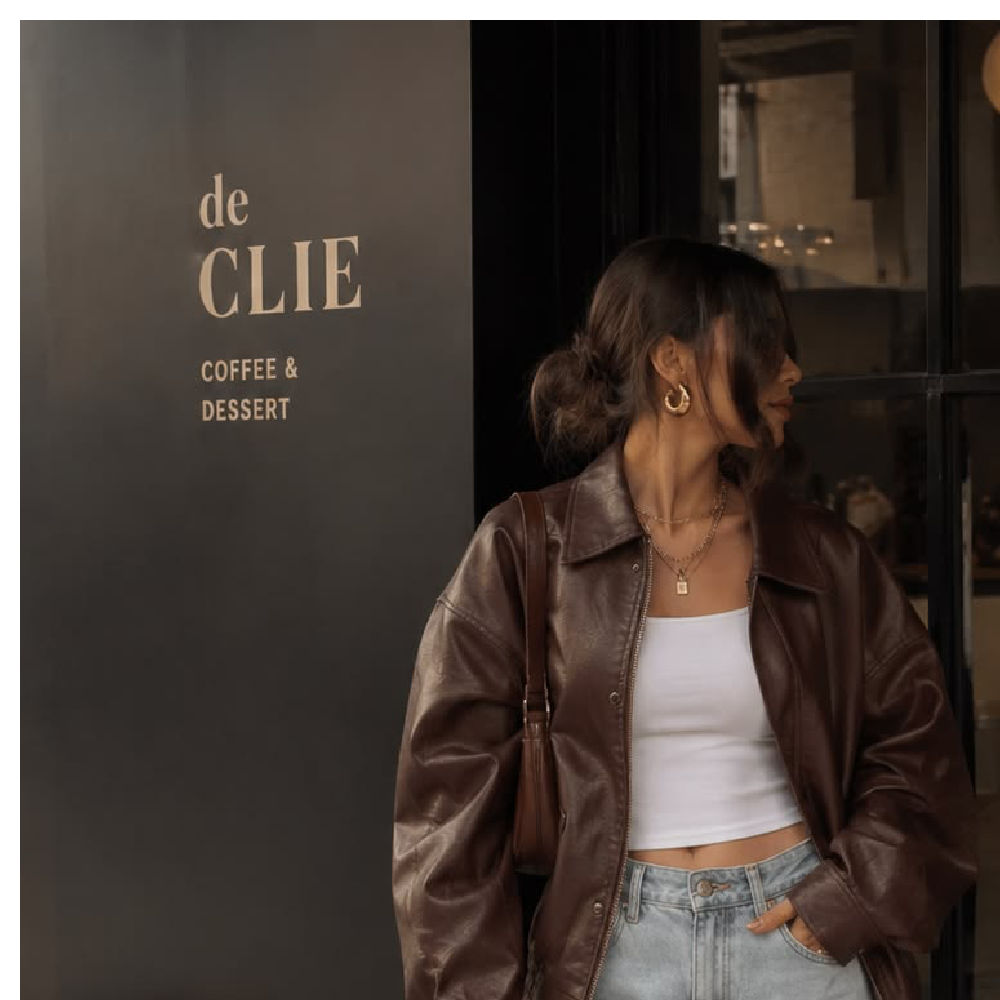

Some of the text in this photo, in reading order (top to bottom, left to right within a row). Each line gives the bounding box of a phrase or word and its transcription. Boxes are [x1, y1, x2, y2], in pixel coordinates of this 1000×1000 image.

[199, 173, 248, 229] de
[199, 235, 361, 318] CLIE
[201, 356, 298, 382] COFFEE &
[202, 398, 290, 421] DESSERT
